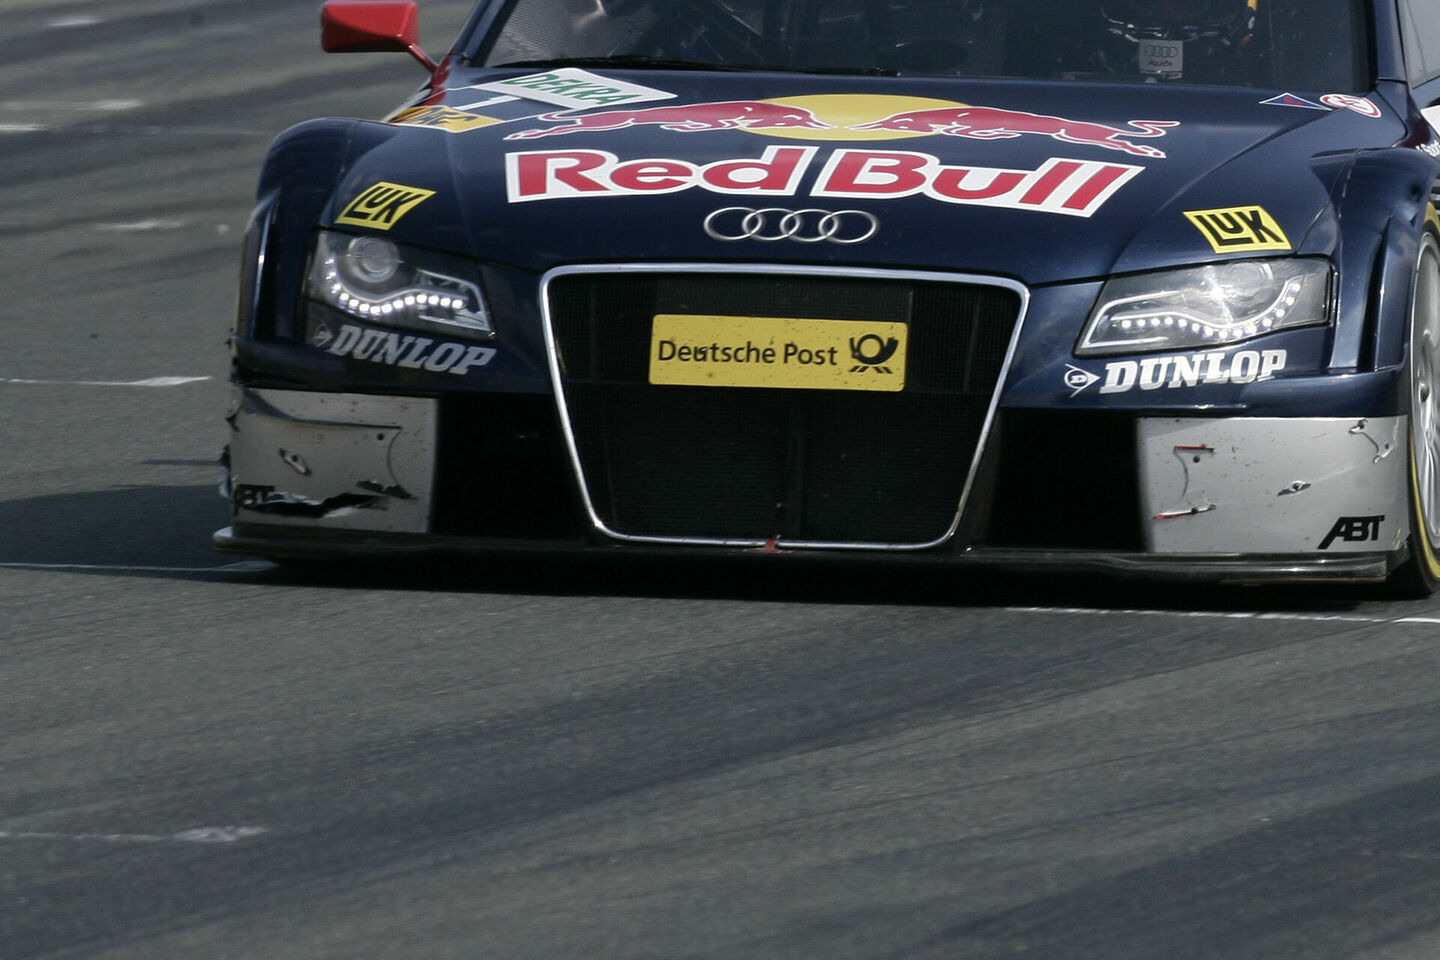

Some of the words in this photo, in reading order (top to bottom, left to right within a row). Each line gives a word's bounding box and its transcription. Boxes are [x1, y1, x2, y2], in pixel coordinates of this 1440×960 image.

[500, 73, 643, 105] DEKRA
[507, 146, 821, 203] Red
[810, 151, 1146, 217] Bull
[325, 324, 497, 375] DUNLOP
[657, 340, 776, 363] Deutsche
[783, 343, 838, 365] Post
[1099, 349, 1287, 394] DUNLOP
[1317, 514, 1385, 549] ABT
